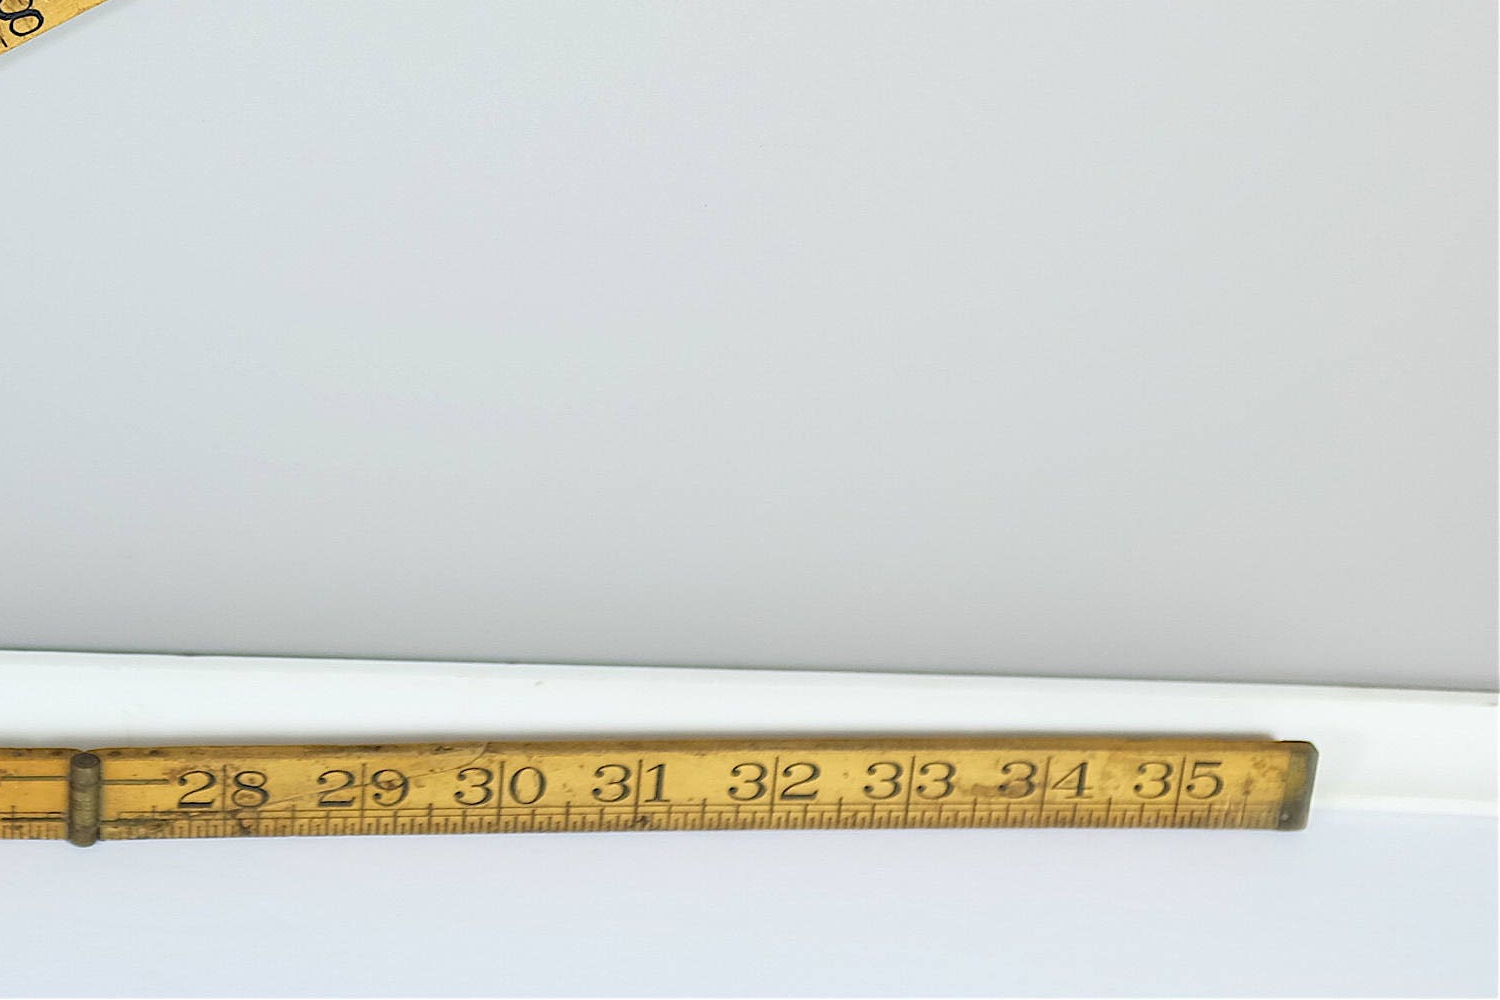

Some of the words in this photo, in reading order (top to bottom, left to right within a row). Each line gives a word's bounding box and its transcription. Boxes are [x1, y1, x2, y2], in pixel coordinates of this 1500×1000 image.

[176, 769, 270, 809] 28
[316, 768, 410, 807] 29
[453, 766, 547, 806] 30
[591, 762, 671, 804] 31
[727, 761, 822, 801] 32
[862, 761, 957, 801] 33
[999, 760, 1095, 801] 34
[1132, 761, 1225, 801] 35
